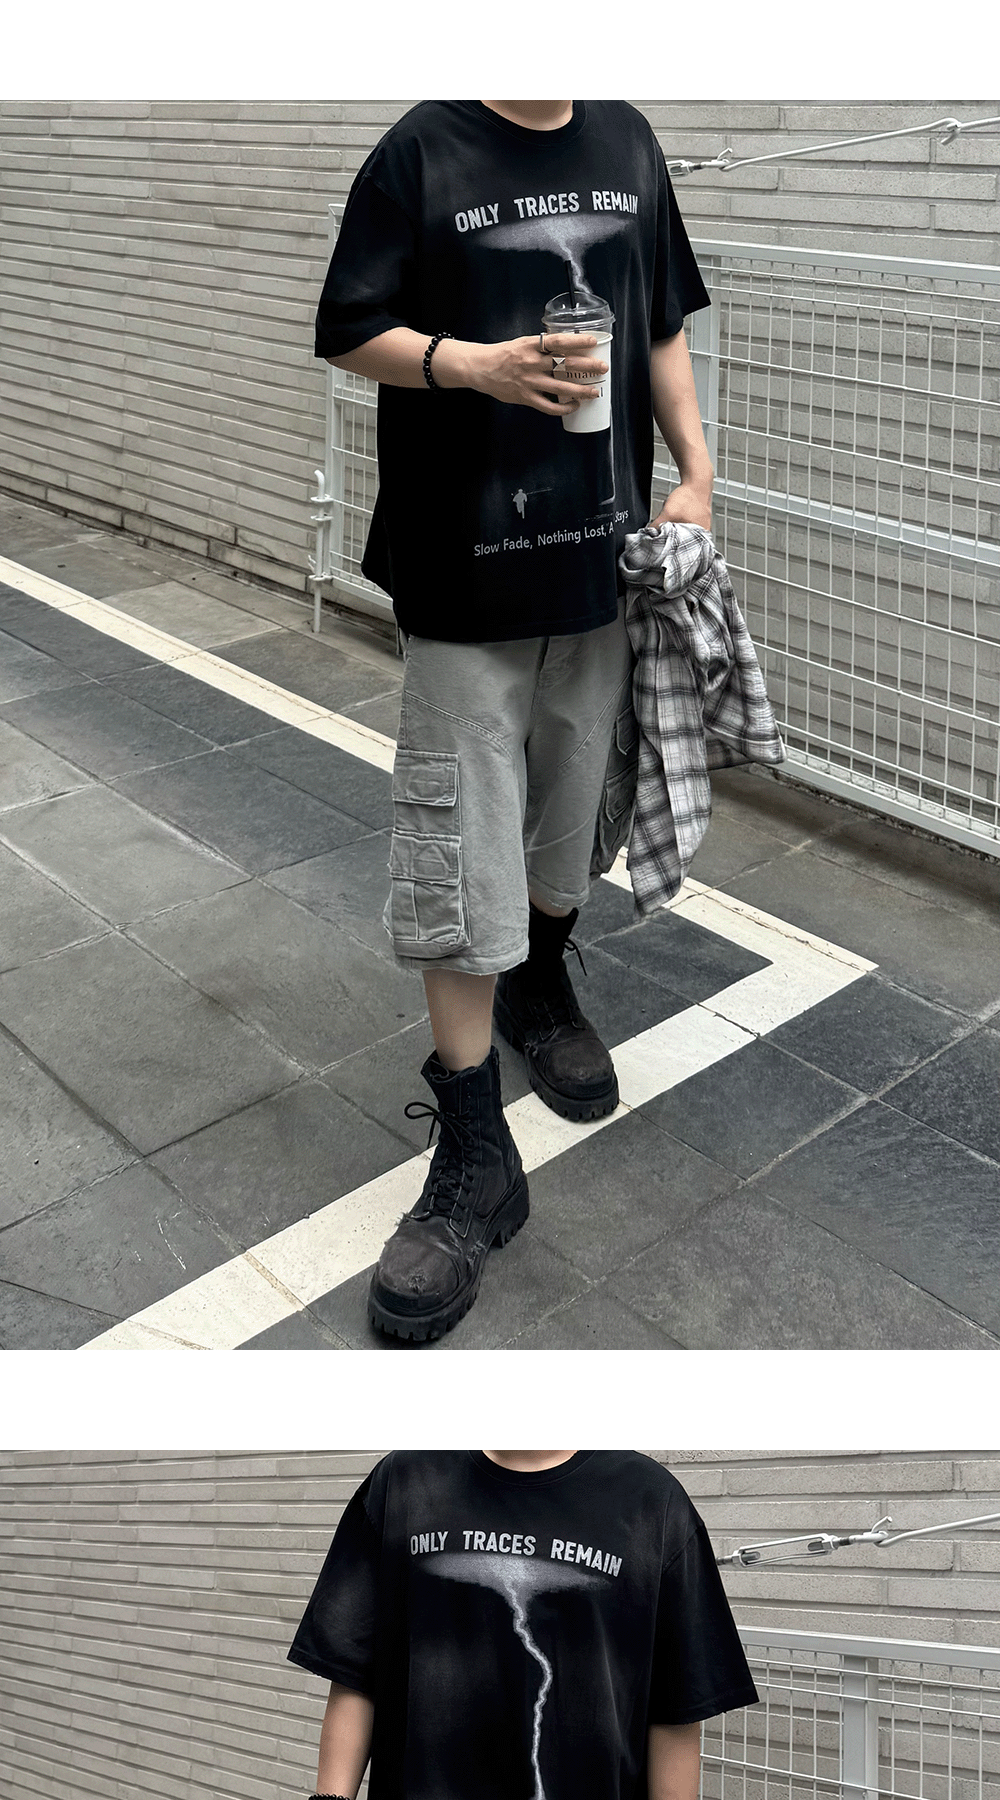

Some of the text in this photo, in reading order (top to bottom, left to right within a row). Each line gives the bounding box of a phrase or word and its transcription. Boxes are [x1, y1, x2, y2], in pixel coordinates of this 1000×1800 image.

[454, 190, 639, 233] ONLY TRACES REMAIN
[474, 542, 500, 557] Slow
[503, 536, 533, 551] Fade,
[537, 529, 582, 547] Nothing
[584, 524, 607, 539] Lost,
[410, 1530, 623, 1577] ONLY TRACES REMAIN
